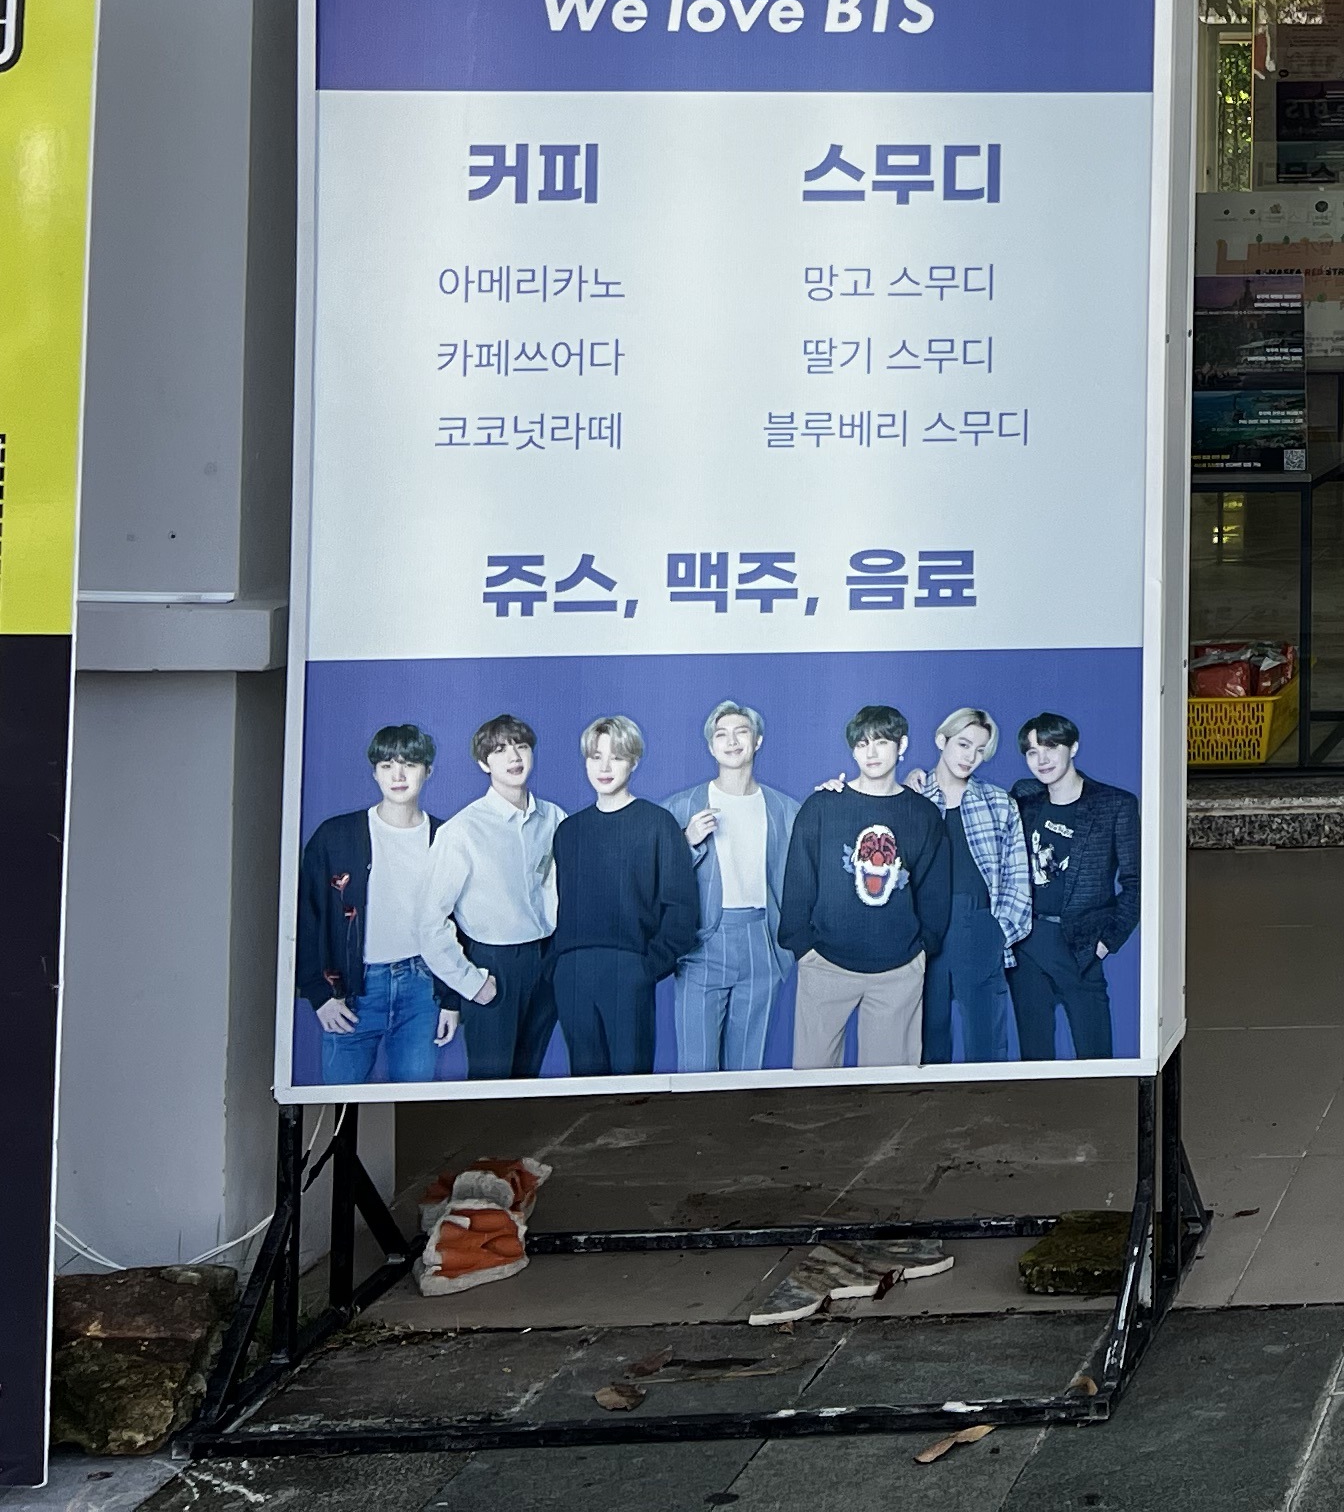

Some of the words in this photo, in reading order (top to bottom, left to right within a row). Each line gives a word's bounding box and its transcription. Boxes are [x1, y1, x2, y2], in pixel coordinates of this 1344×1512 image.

[467, 143, 600, 204] 커피
[802, 143, 1001, 205] 스무디
[438, 265, 625, 303] 아메리카노
[804, 264, 875, 301] 망고
[887, 263, 995, 301] 스무디
[437, 338, 625, 376] 카페쓰어다
[803, 337, 872, 375] 딸기
[886, 336, 993, 374] 스무디
[434, 411, 623, 450] 코코넛라떼
[763, 410, 909, 449] 블루베리
[922, 408, 1029, 447] 스무디
[482, 553, 638, 619] 쥬스,
[666, 551, 819, 616] 맥주,
[845, 548, 977, 611] 음료
